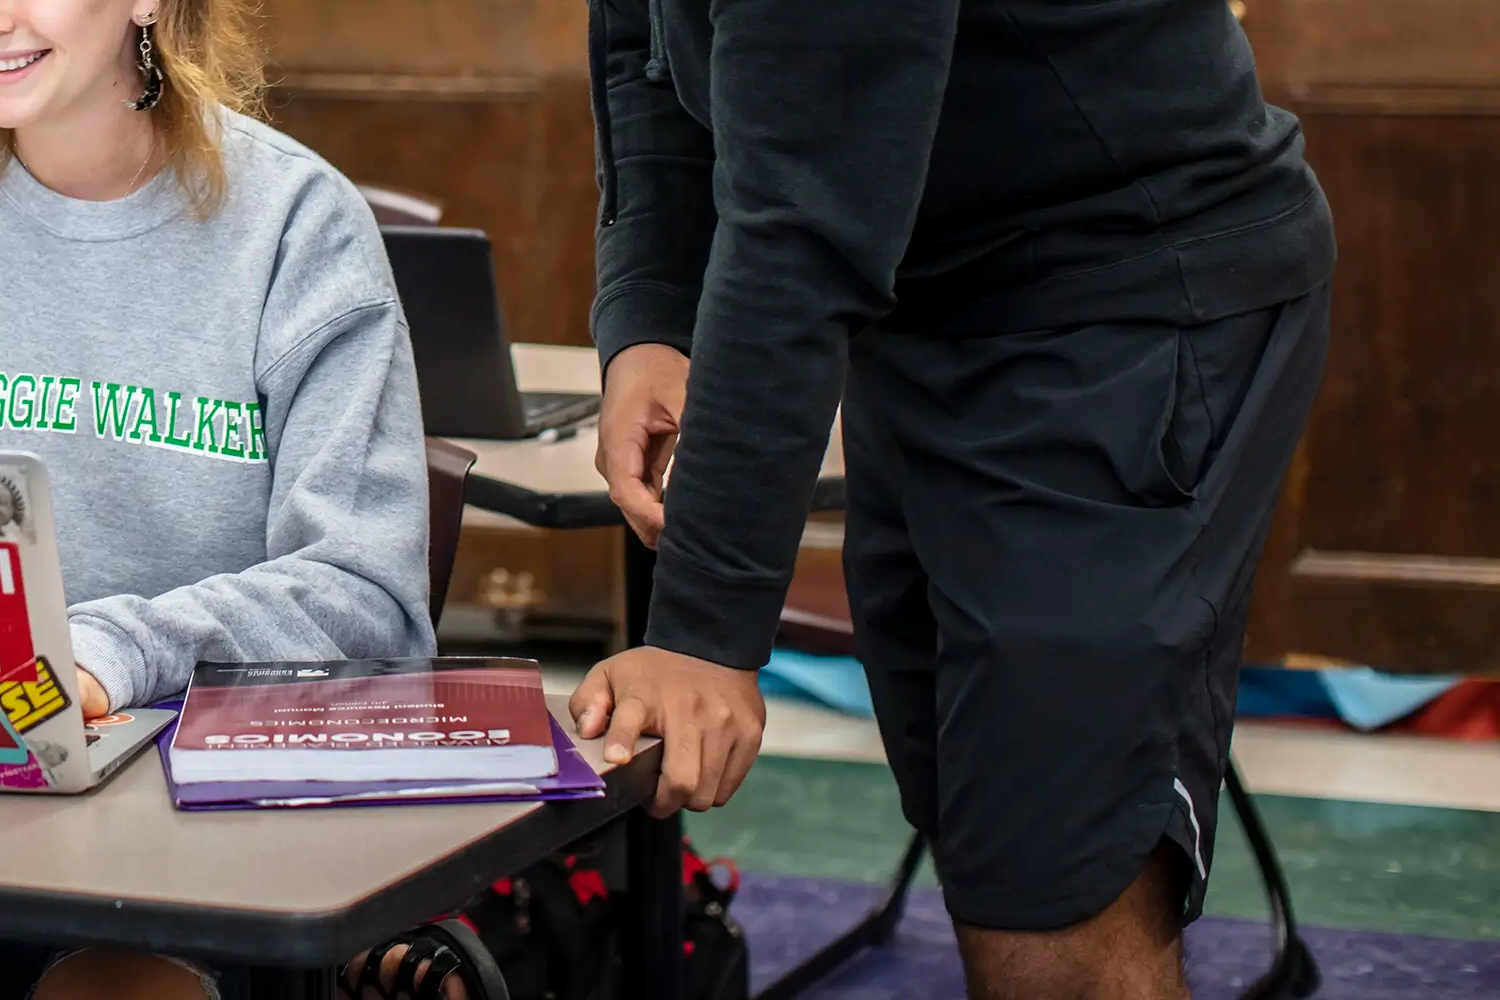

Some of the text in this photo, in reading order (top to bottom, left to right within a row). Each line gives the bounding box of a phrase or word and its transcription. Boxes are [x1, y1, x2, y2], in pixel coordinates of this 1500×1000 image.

[90, 381, 269, 464] WALKER
[273, 706, 325, 714] Manual
[250, 715, 468, 727] MICROECONOMICS
[204, 729, 510, 745] ECONOMICS
